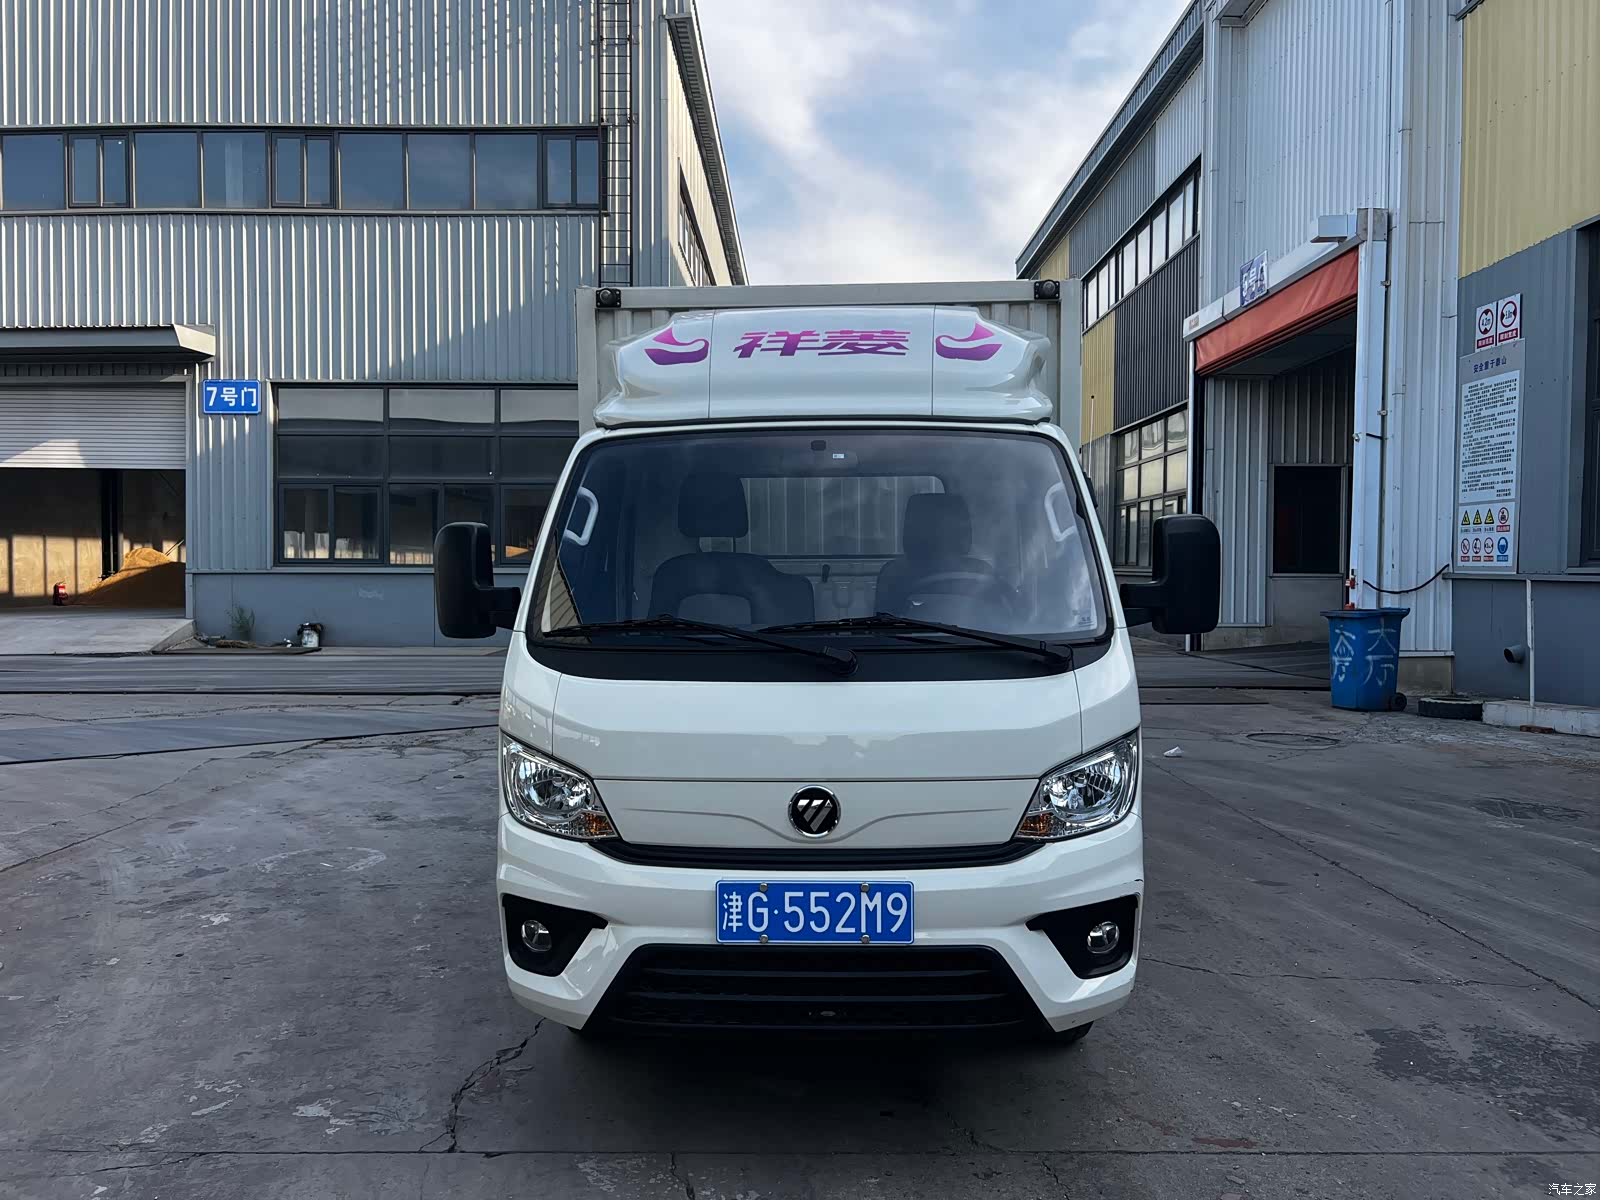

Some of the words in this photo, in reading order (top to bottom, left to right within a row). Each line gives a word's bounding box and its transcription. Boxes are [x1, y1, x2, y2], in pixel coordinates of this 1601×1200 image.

[733, 330, 911, 359] 祥菱
[206, 386, 257, 407] 7号门
[722, 891, 908, 934] 津G·552M9
